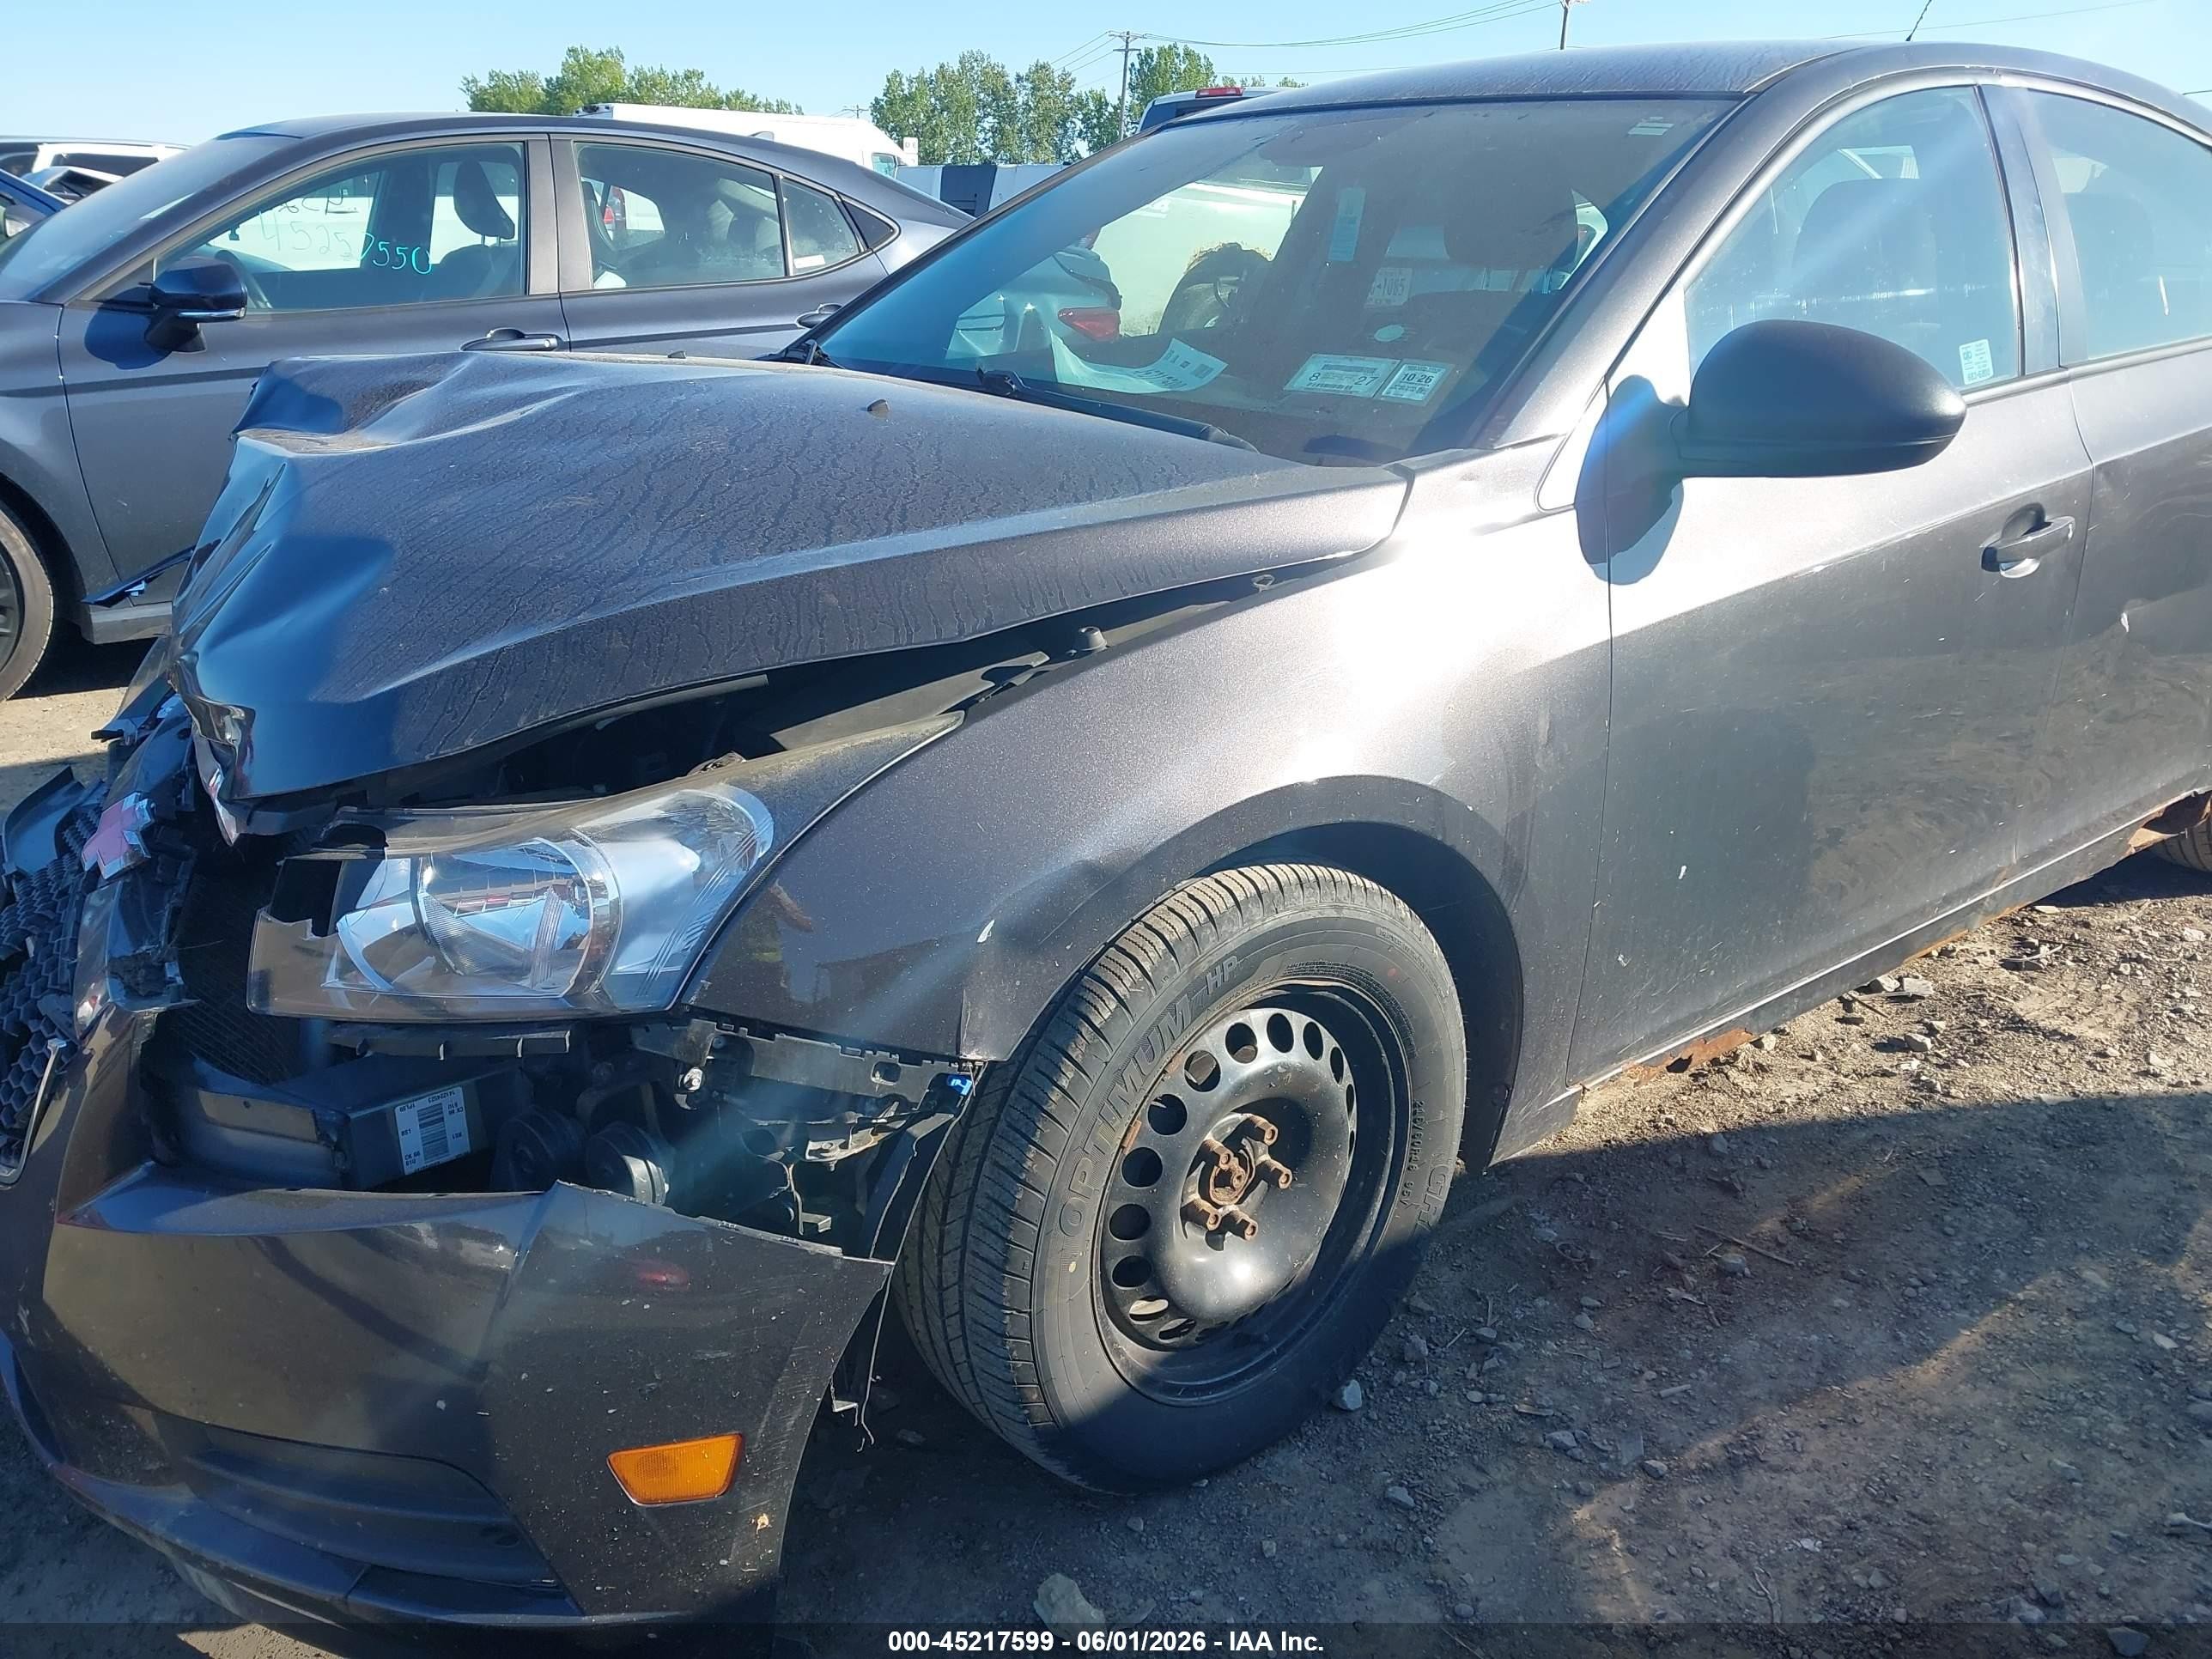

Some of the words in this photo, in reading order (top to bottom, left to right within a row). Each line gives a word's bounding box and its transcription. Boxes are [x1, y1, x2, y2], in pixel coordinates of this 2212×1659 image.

[1308, 372, 1321, 382] 8
[1354, 375, 1379, 386] 27
[1401, 372, 1416, 382] 10
[1416, 374, 1435, 384] 26
[1205, 955, 1238, 996] HP
